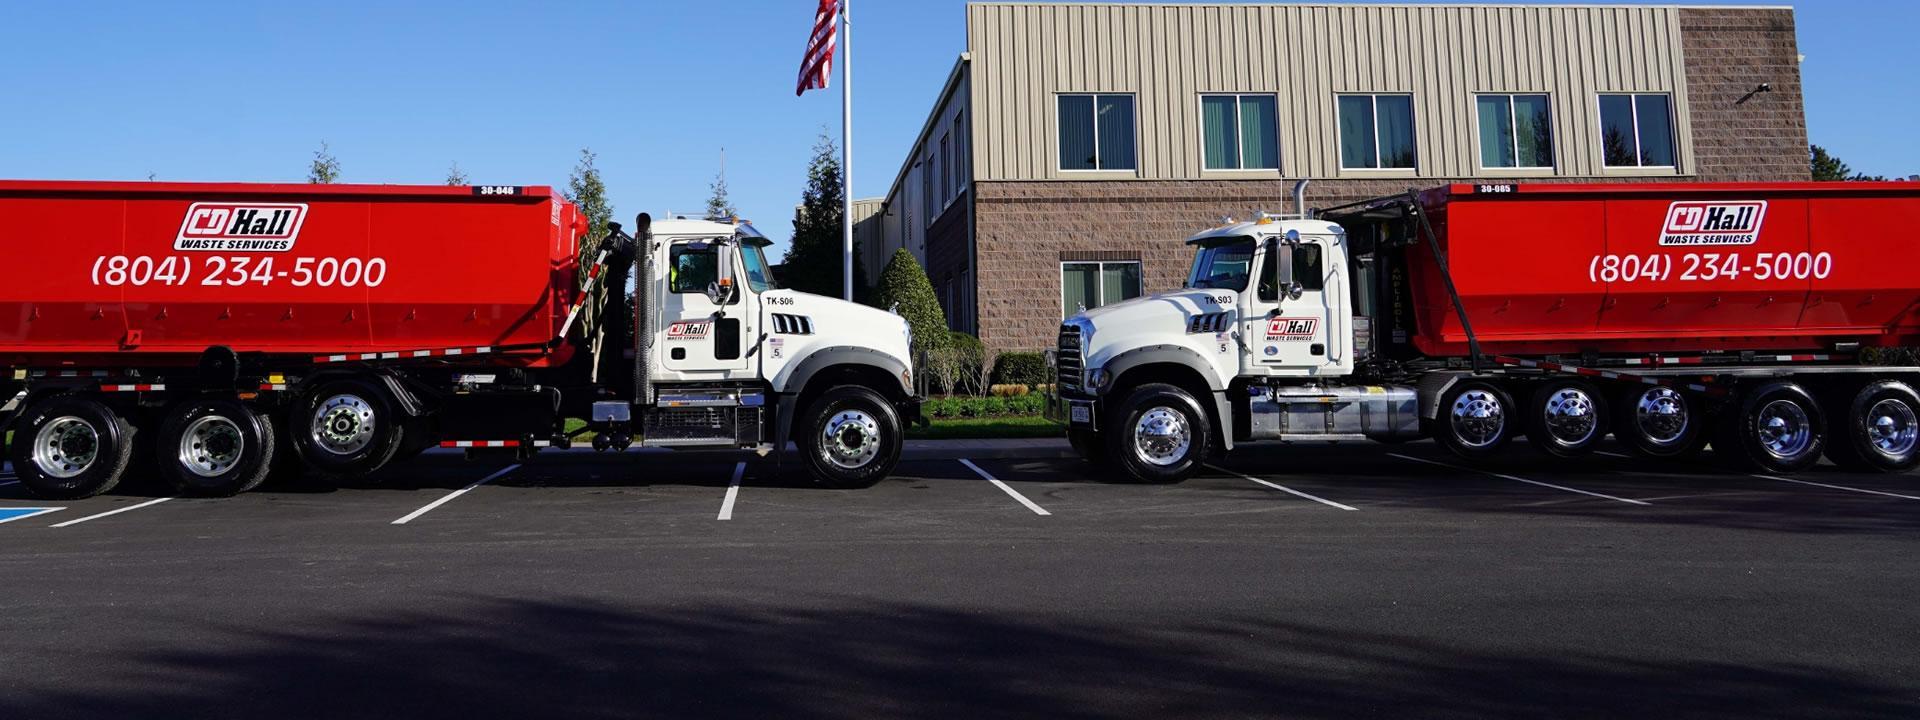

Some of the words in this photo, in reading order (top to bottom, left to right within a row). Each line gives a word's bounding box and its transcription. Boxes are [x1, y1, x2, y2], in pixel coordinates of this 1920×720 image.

[481, 186, 514, 195] 30-046
[1481, 184, 1511, 193] 30-085
[187, 208, 231, 235] CD
[229, 209, 292, 235] Hall
[1668, 207, 1704, 231] CD
[1703, 206, 1754, 231] Hall
[1664, 235, 1700, 244] WASTE
[1702, 234, 1752, 243] SERVICES
[180, 239, 225, 250] WASTE
[226, 239, 289, 250] SERVICES
[91, 255, 191, 287] (804)
[201, 255, 387, 287] 234-5000
[1589, 254, 1672, 282] (804)
[1680, 252, 1832, 281] 234-5000
[766, 296, 794, 305] TK-S06
[1204, 295, 1232, 305] TK-S03
[684, 324, 706, 335] Hall
[1287, 320, 1313, 334] Hall
[774, 348, 780, 357] 5
[1220, 343, 1227, 352] 5
